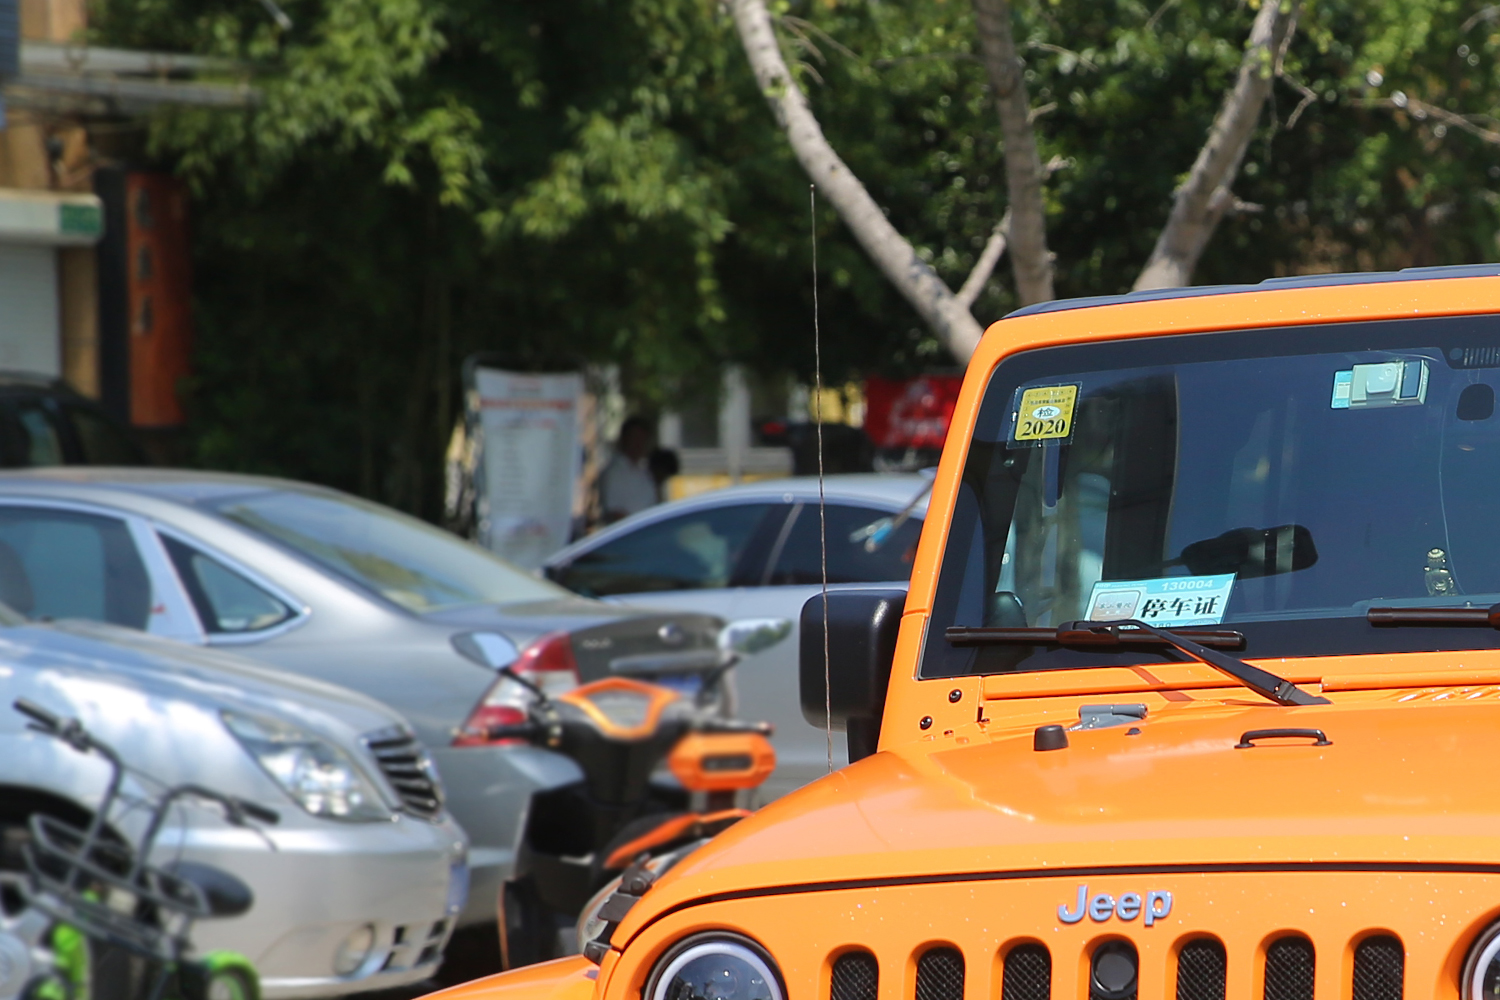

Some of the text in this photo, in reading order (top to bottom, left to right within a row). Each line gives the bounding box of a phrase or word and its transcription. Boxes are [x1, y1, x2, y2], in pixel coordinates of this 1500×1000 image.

[1037, 407, 1055, 418] 检
[1021, 419, 1066, 437] 2020
[1161, 579, 1214, 591] 130004
[1140, 595, 1221, 618] 停车证
[1058, 884, 1172, 928] Jeep
